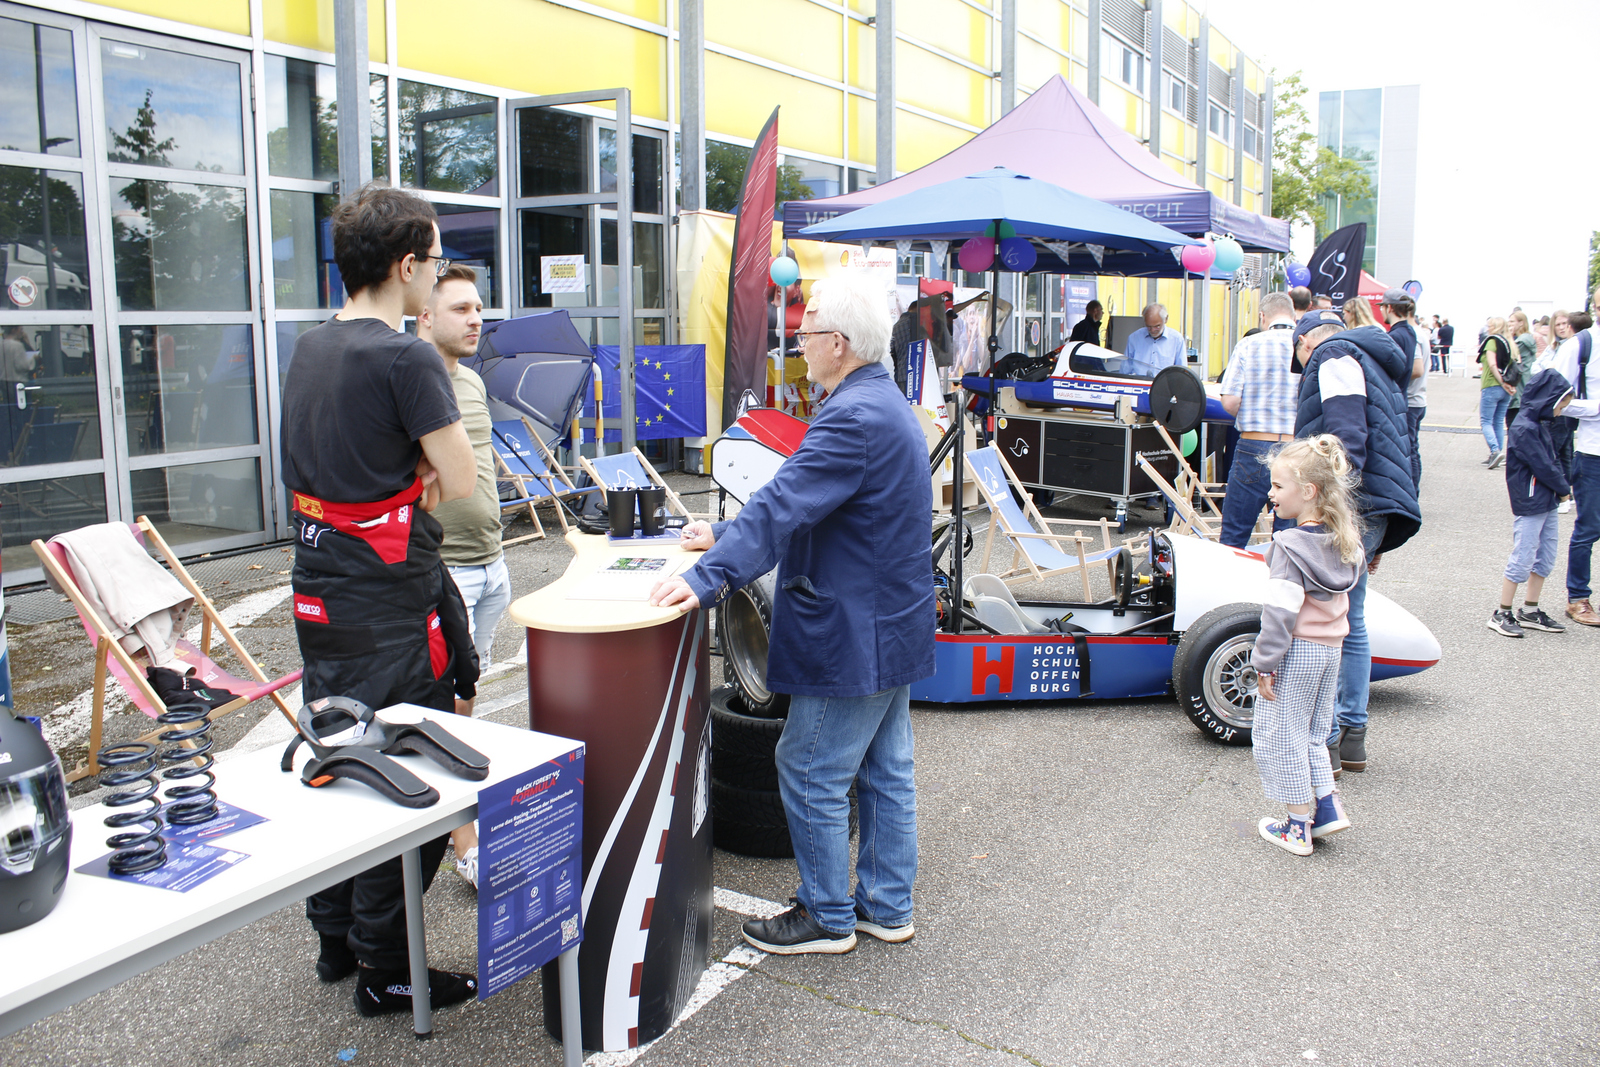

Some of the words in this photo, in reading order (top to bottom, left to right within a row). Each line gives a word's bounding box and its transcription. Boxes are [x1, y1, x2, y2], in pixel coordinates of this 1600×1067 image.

[1114, 202, 1184, 218] PECHT
[1053, 380, 1150, 394] SCHLUCKSPECH
[297, 602, 320, 615] sparco
[1034, 646, 1075, 655] HOCH
[1032, 658, 1080, 667] SCHUL
[1030, 671, 1080, 680] OFFEN
[1030, 684, 1070, 693] BURG
[1191, 696, 1237, 741] Hoosier
[511, 777, 556, 805] FORMULA
[516, 783, 532, 795] BLACK
[533, 774, 551, 786] FOREST
[491, 823, 504, 832] Lerne
[514, 805, 542, 821] Racing-Team
[550, 790, 573, 804] Hochschule
[514, 813, 537, 826] Offenburg
[538, 805, 552, 815] kennen
[494, 936, 518, 954] Interesse?
[519, 930, 531, 940] Dann
[532, 922, 544, 932] melde
[545, 916, 554, 924] Dich
